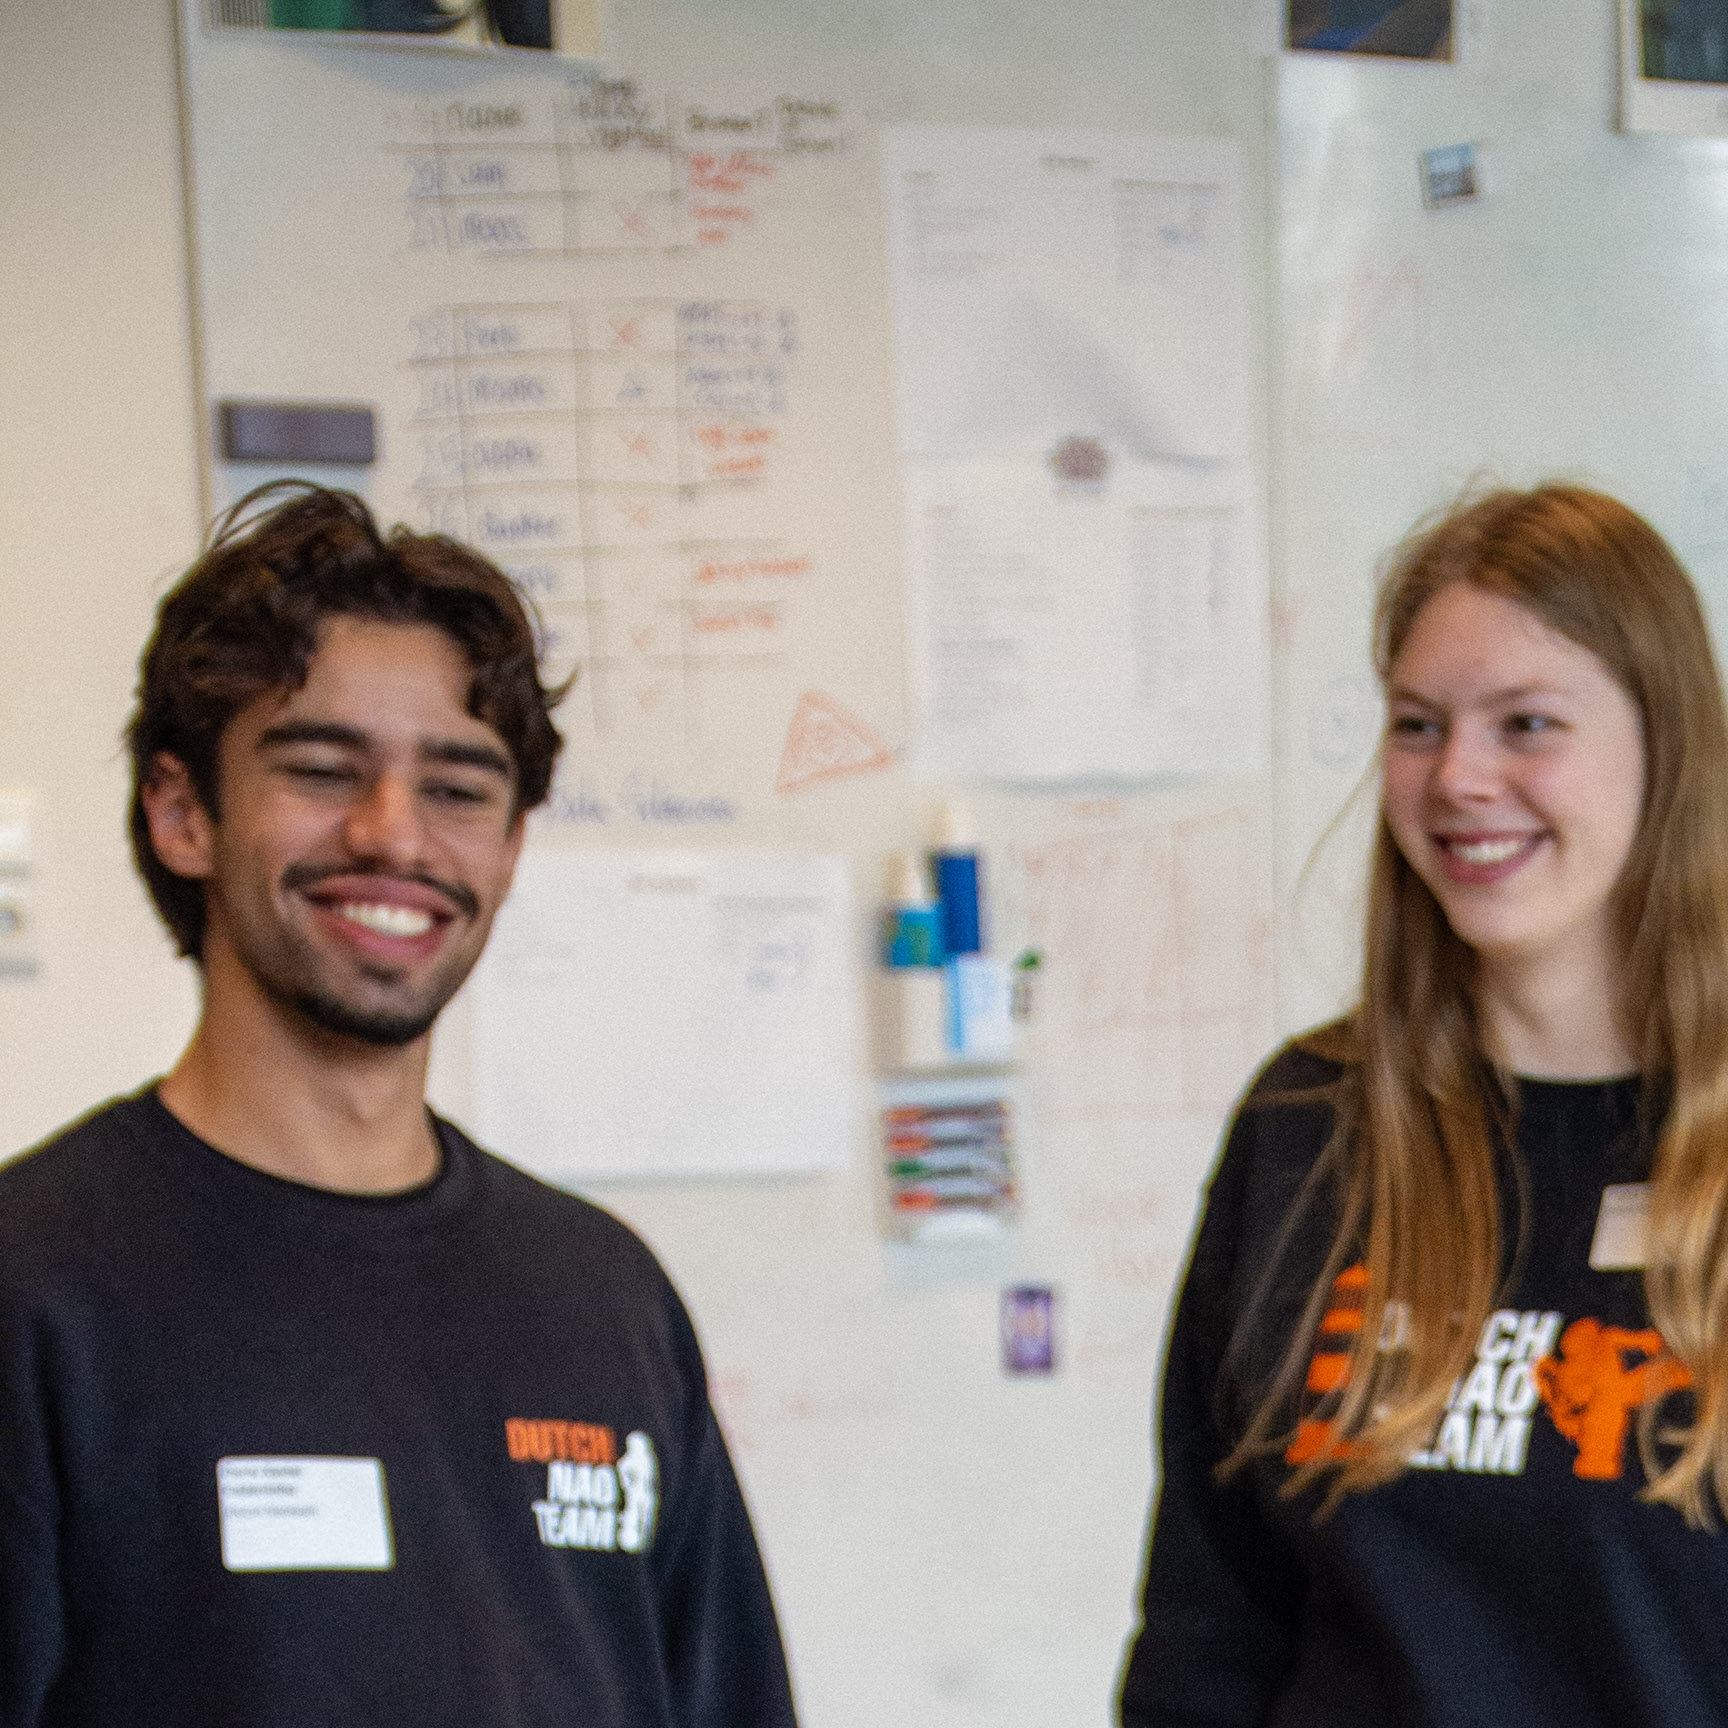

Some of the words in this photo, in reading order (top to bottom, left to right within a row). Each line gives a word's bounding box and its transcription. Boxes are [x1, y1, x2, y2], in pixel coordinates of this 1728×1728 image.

[1448, 1357, 1541, 1414] AO
[1406, 1410, 1529, 1477] AM
[530, 1499, 617, 1552] TEAM
